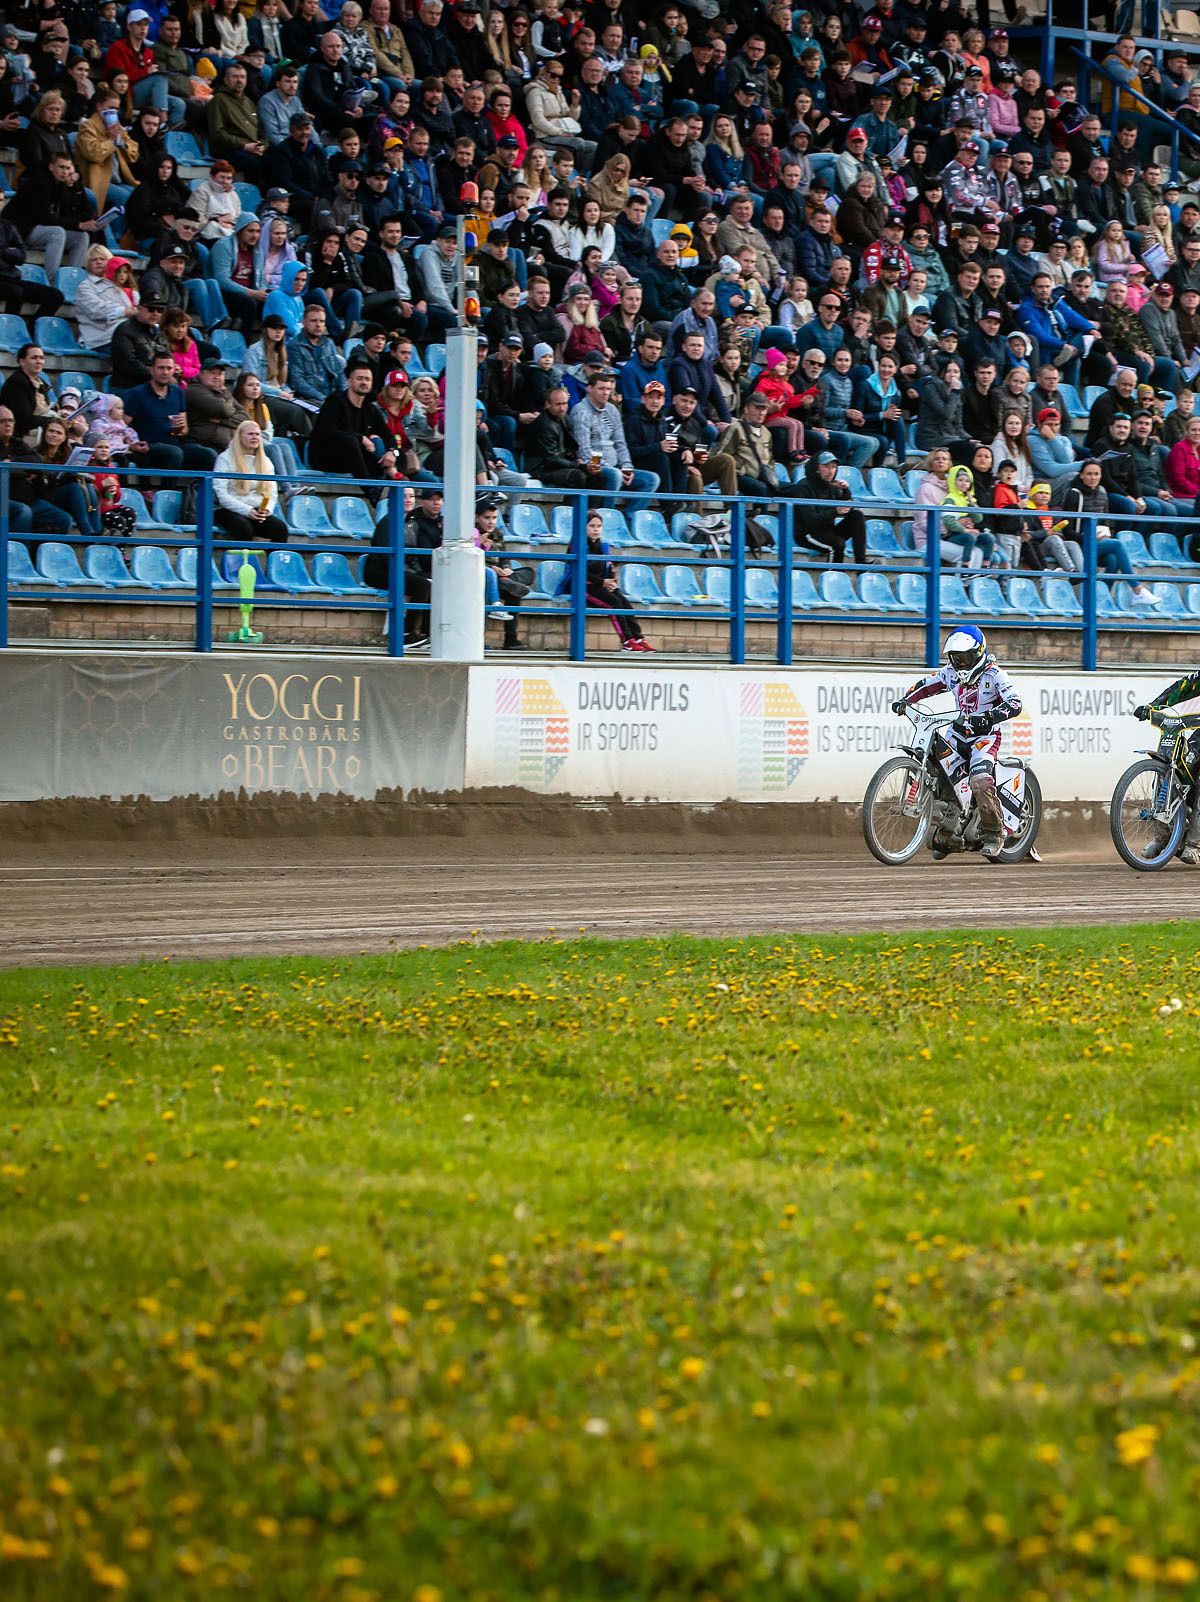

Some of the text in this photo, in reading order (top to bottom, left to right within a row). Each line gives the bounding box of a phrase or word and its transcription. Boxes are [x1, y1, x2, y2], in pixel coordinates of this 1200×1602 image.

[222, 673, 362, 721] YOGGI
[578, 682, 689, 711] DAUGAVPILS
[1040, 689, 1136, 716] DAUGAVPILS
[222, 725, 361, 742] GASTROBĀRS
[577, 723, 658, 751] IR SPORTS
[817, 725, 912, 752] IS SPEEDWAY
[1040, 728, 1111, 753] IR SPORTS
[244, 745, 344, 789] BEAR
